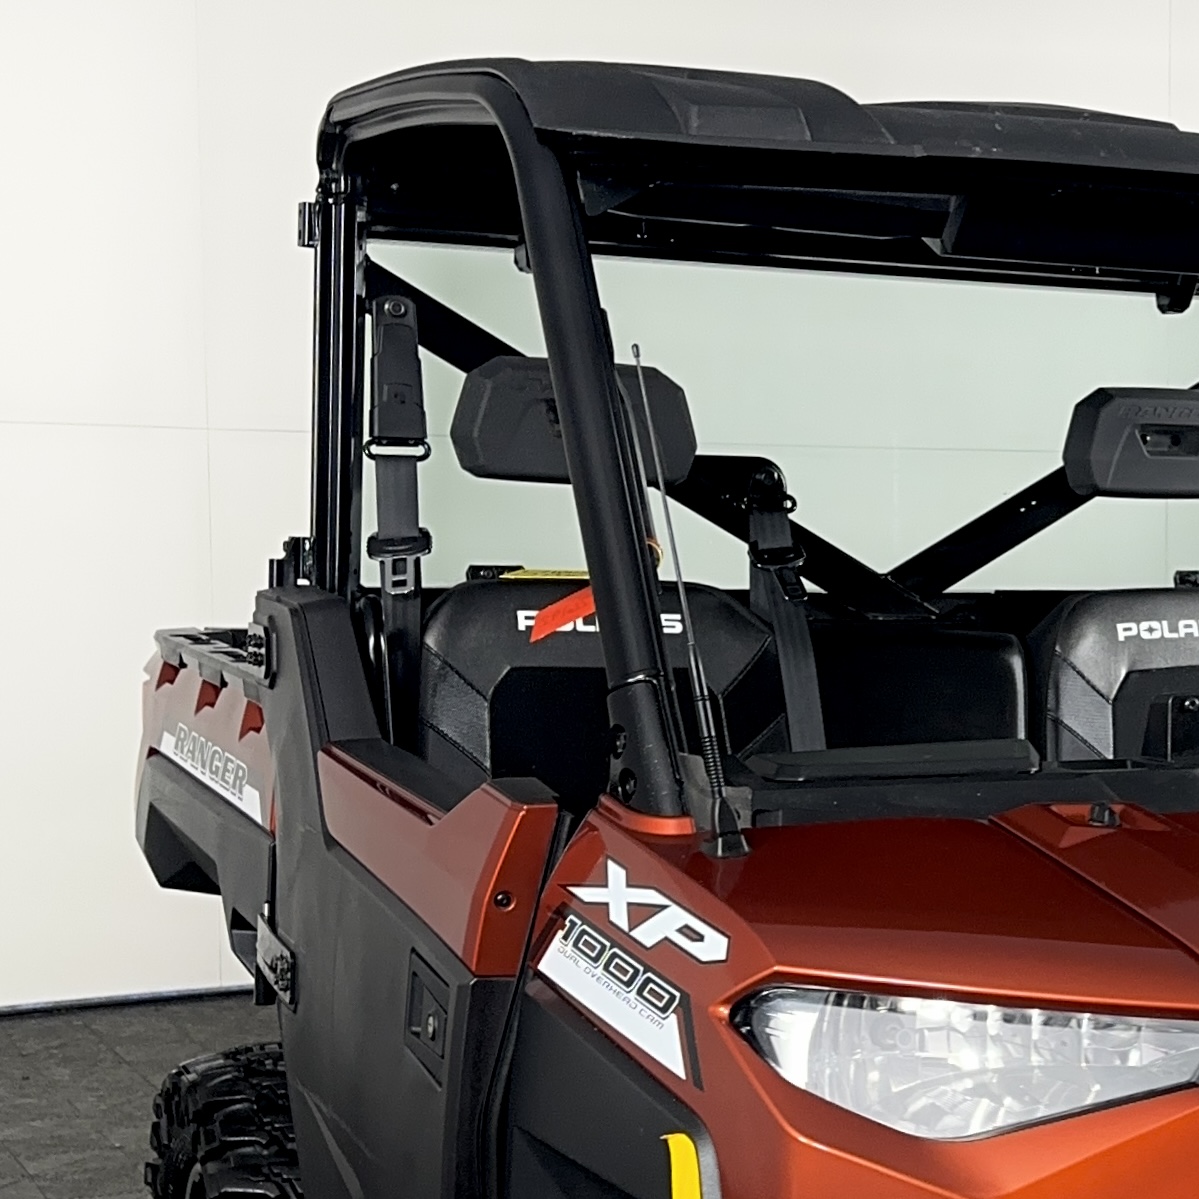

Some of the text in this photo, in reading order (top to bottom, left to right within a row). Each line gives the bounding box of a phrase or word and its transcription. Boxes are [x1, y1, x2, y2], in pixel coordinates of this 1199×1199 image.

[173, 722, 248, 802] RANGER
[560, 856, 731, 964] XP
[557, 946, 665, 1030] DUAL OVERHEAD CAM
[558, 914, 681, 1021] 1000
